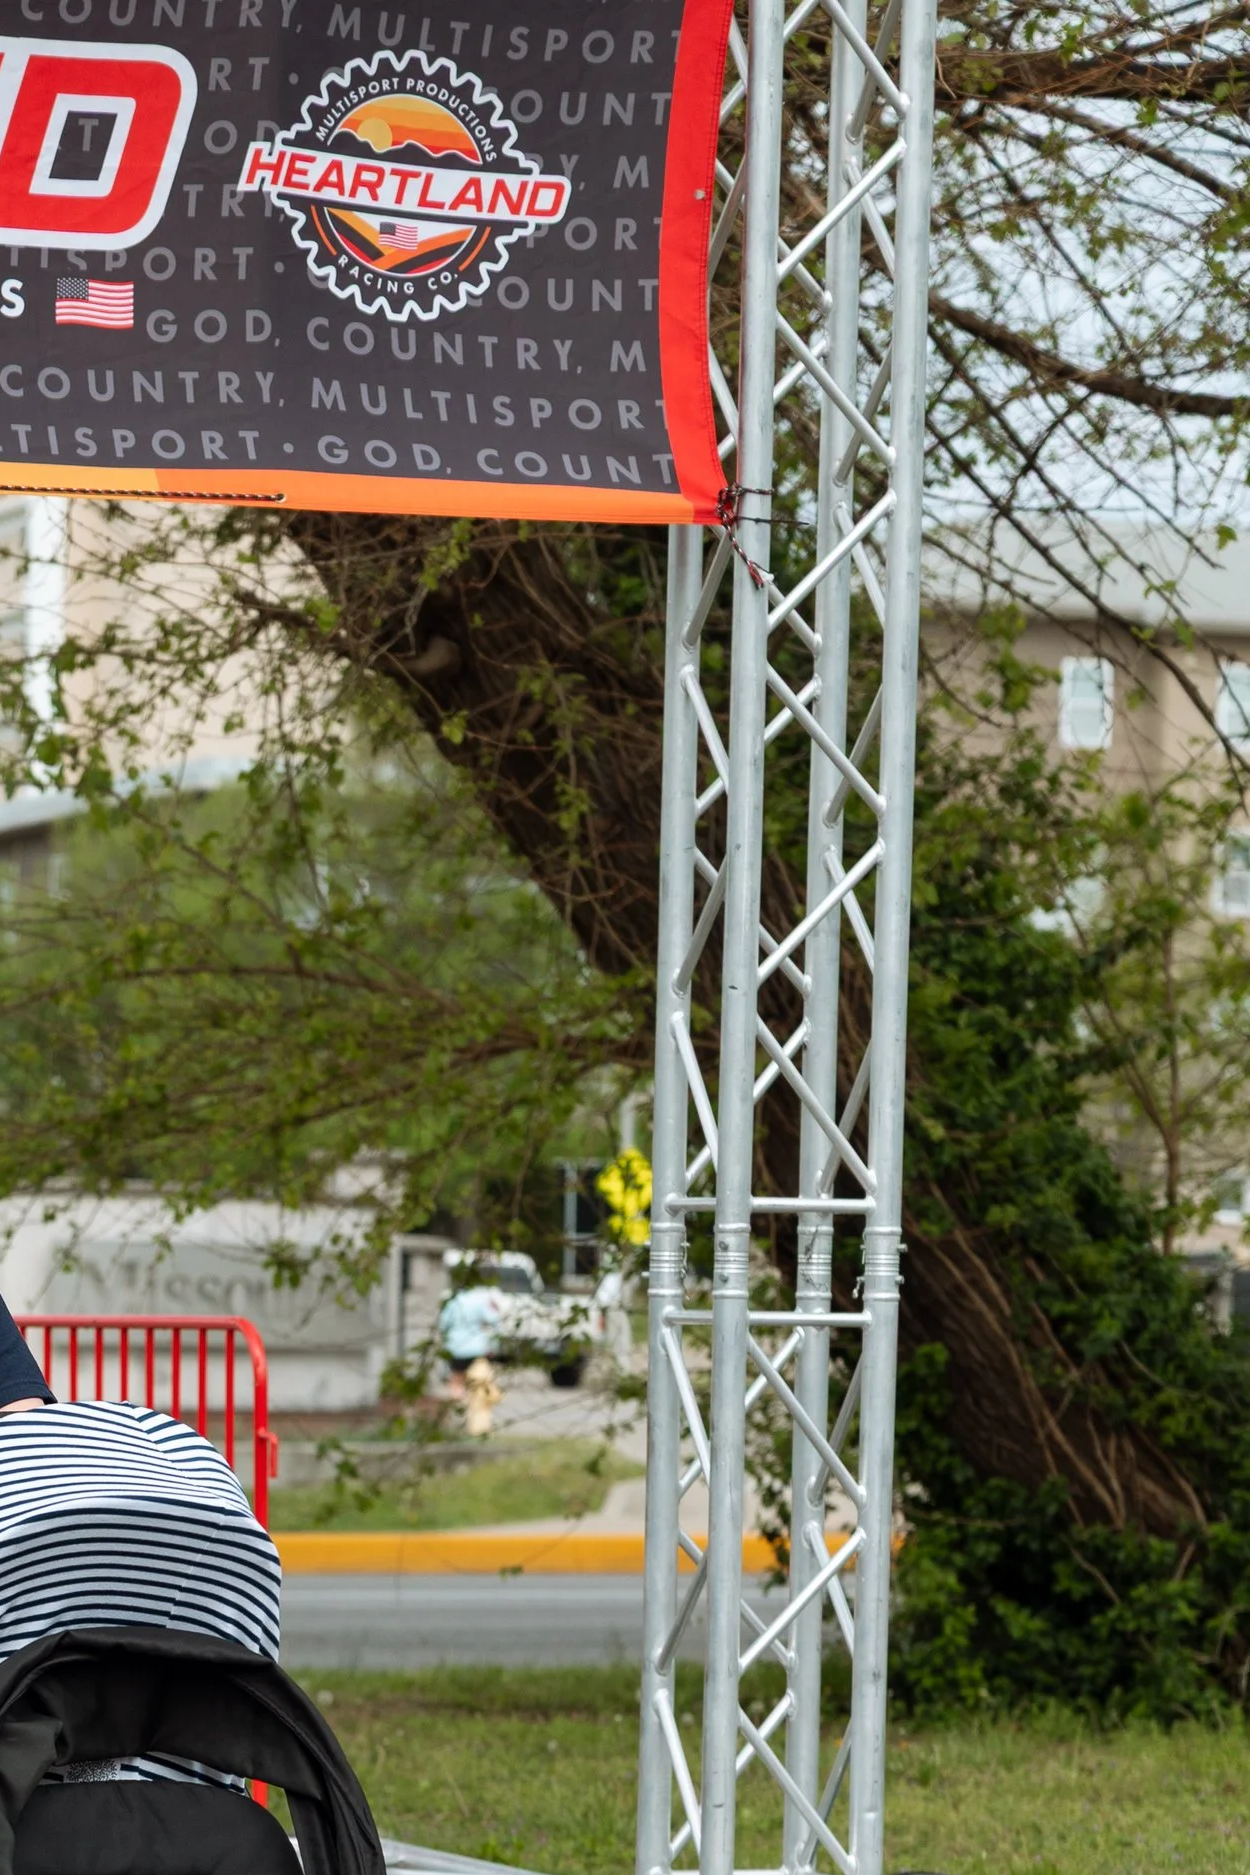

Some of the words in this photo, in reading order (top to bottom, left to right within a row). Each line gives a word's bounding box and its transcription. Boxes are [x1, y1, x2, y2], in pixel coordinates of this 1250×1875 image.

[316, 78, 400, 142] MULTISPORT
[406, 78, 498, 163] PRODUCTIONS
[484, 86, 672, 126] OUNT
[246, 148, 566, 218] HEARTLAND
[337, 254, 415, 296] RACING
[427, 271, 459, 292] CO.
[467, 275, 659, 312] OUNT
[146, 308, 280, 347] GOD,
[306, 316, 583, 375] COUNTRY,
[317, 434, 455, 476] GOD,
